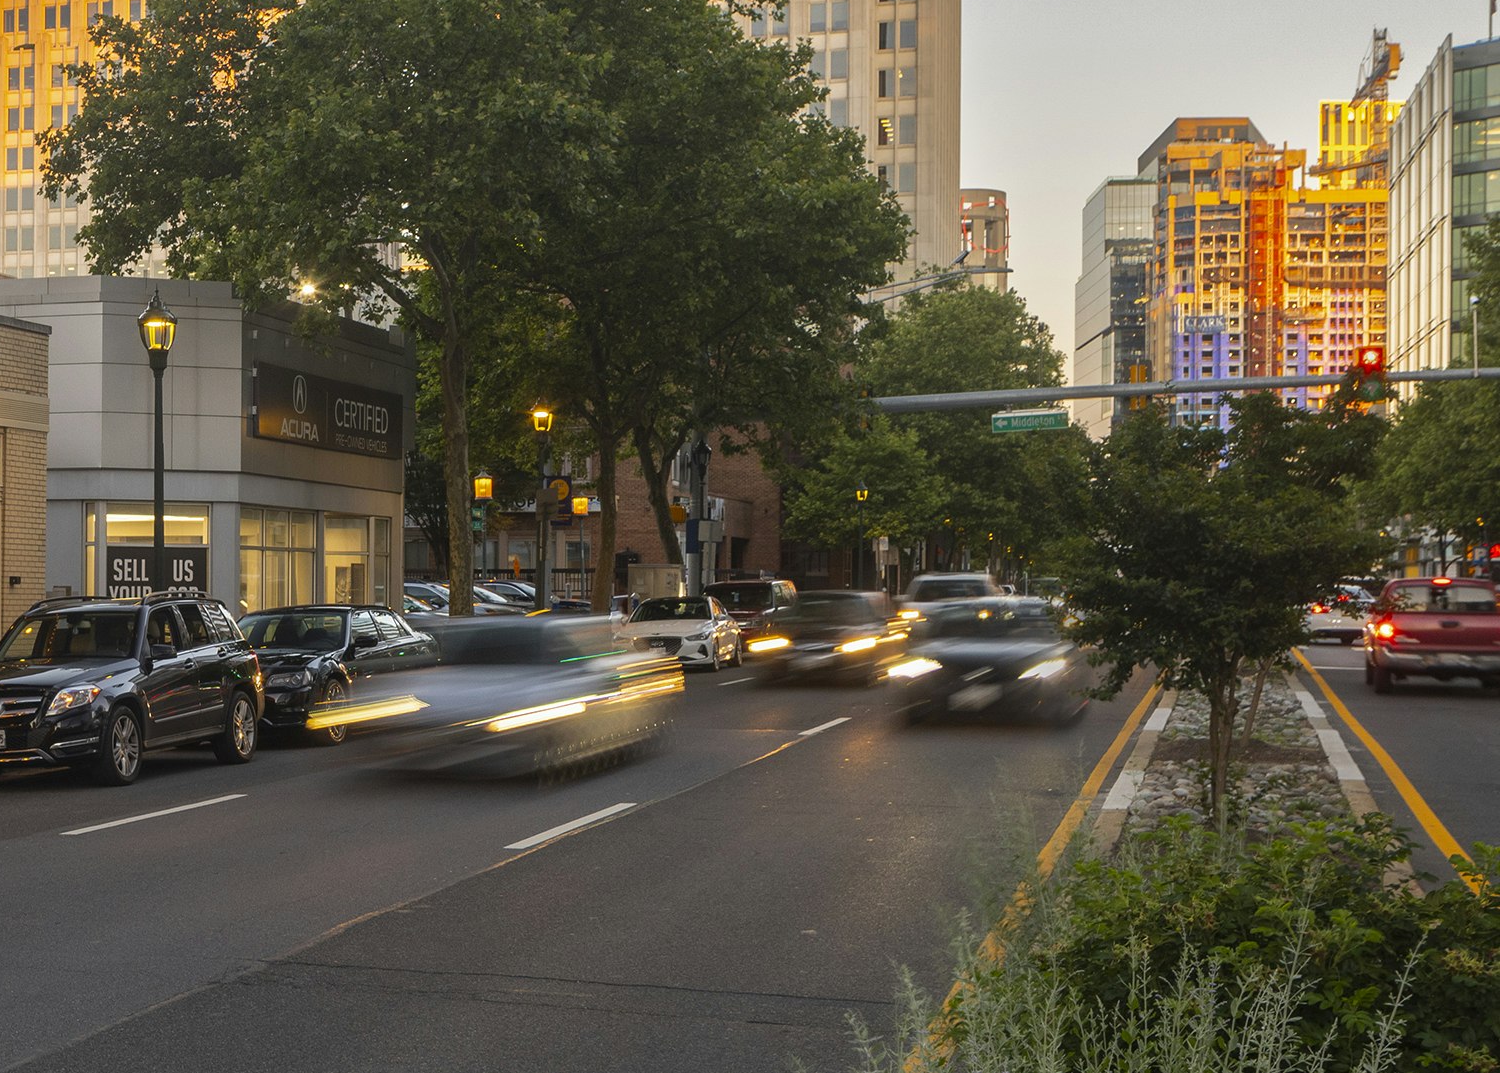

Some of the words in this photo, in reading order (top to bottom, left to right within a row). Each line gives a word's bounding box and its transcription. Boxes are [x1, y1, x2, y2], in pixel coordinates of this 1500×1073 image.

[1185, 317, 1225, 329] CLARK
[334, 398, 389, 435] CERTIFIED
[1011, 415, 1055, 428] Middleton
[280, 417, 320, 442] ACURA
[335, 433, 366, 450] PRE-OWNED
[366, 438, 388, 454] VEHICLES
[113, 558, 149, 582] SELL
[173, 559, 194, 582] US
